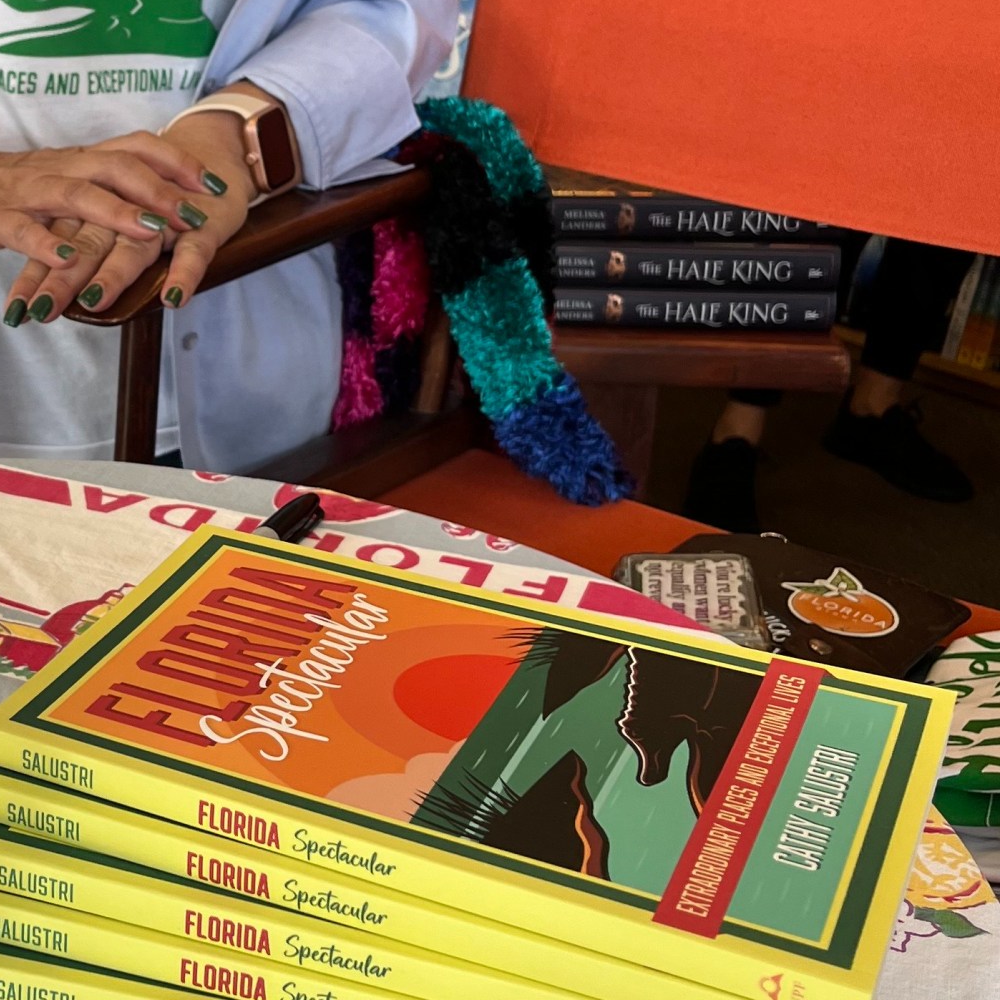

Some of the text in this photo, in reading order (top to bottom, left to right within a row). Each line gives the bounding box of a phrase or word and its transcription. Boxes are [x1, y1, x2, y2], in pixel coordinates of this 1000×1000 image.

[44, 72, 80, 96] AND
[88, 69, 174, 95] EXCEPTIONAL
[560, 220, 606, 230] LANDERS
[563, 210, 605, 220] MELISSA
[648, 210, 801, 237] THE HALF KING
[558, 268, 596, 278] ANDERS
[638, 259, 792, 286] THE HALF KING
[555, 310, 594, 321] ANDERS
[636, 301, 789, 328] THE HALF KING
[713, 594, 737, 622] lucky
[799, 592, 887, 630] FLORIDA
[84, 566, 359, 748] FLORIDA
[199, 592, 389, 762] Spectacular
[771, 674, 806, 703] LIVES
[744, 704, 796, 765] EXCEPTIONAL
[735, 762, 769, 787] AND
[22, 749, 397, 877] SALUSTRI FLORIDA Spectacular
[717, 785, 760, 826] PLACES
[773, 744, 861, 872] CATHY SALUSTRI
[7, 802, 388, 927] SALUSTRI FLORIDA Spectacular
[676, 822, 743, 918] EXTRAORDINARY
[184, 909, 271, 956] FLORIDA
[283, 935, 392, 979] Spectacular
[179, 958, 267, 1000] FLORIDA
